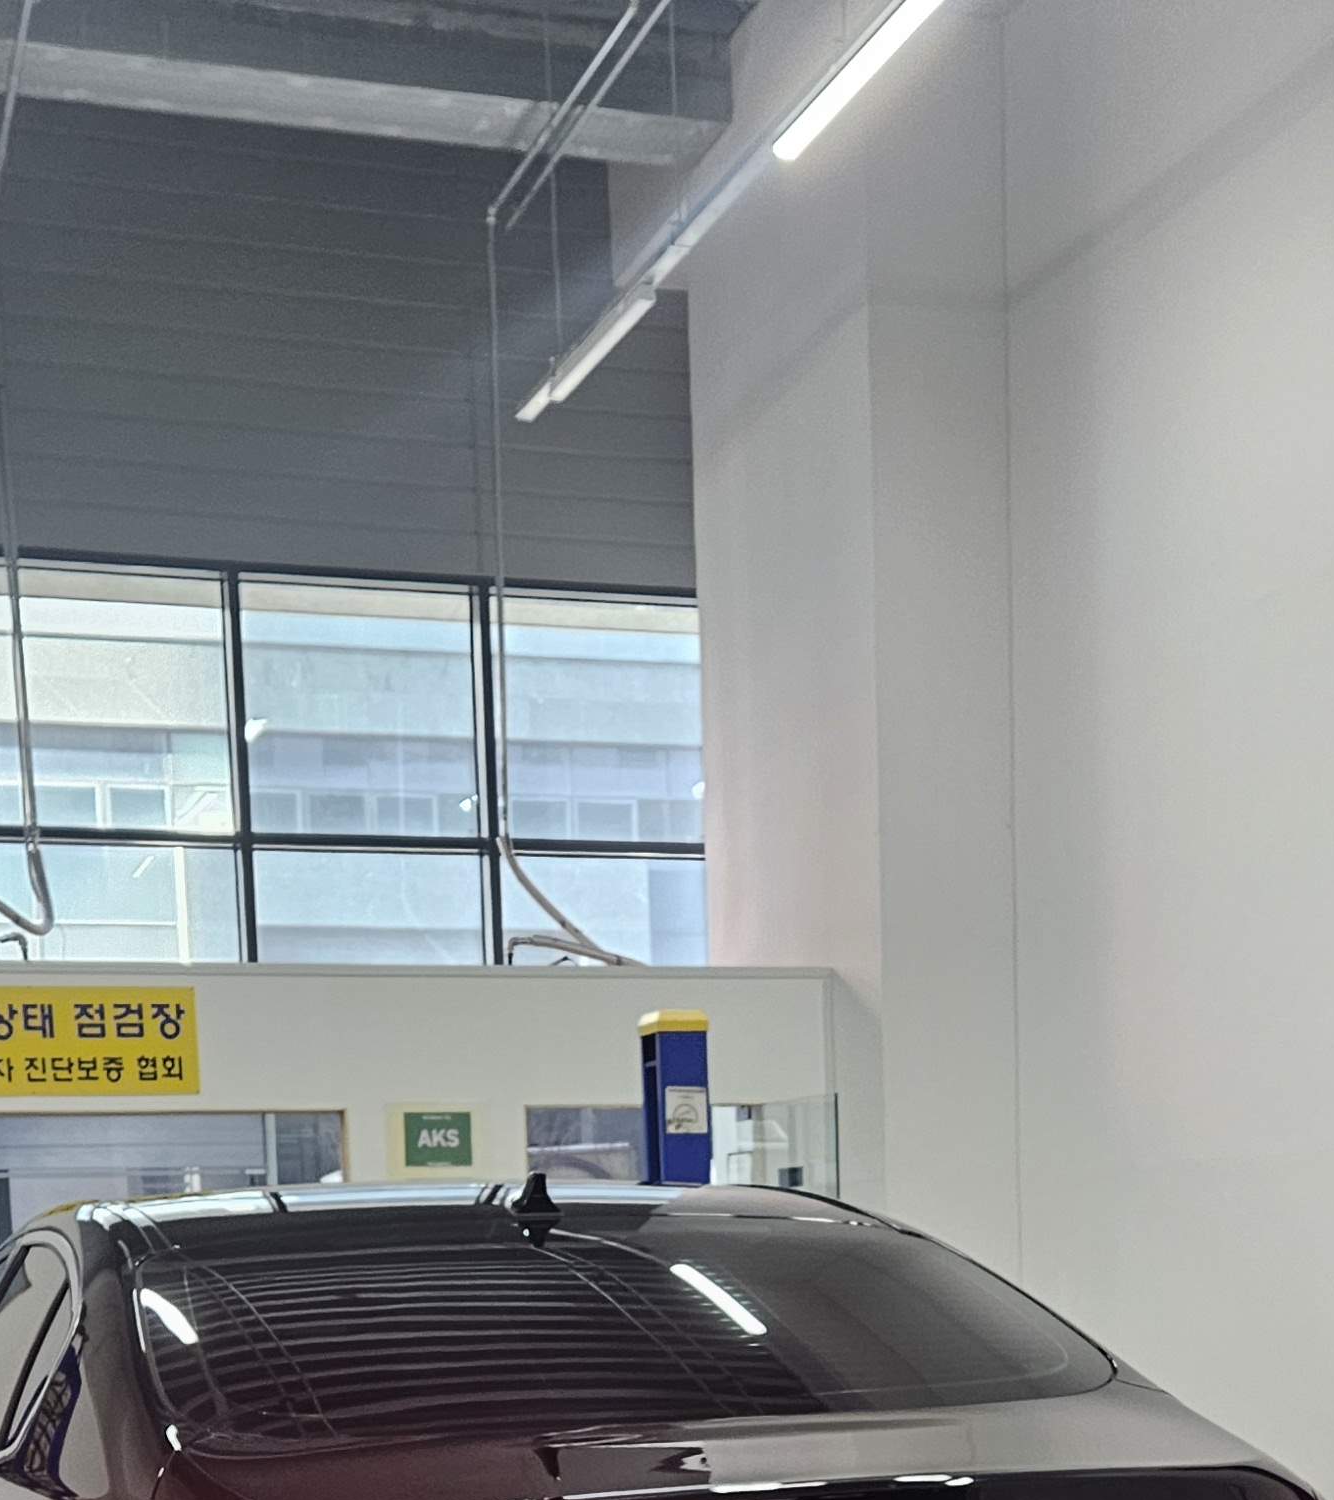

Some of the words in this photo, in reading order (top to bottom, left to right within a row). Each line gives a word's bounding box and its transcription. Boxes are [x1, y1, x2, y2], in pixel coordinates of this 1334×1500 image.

[73, 1003, 185, 1040] 점검장
[24, 1056, 125, 1083] 진단보증
[137, 1055, 184, 1081] 협회
[417, 1128, 460, 1148] AKS
